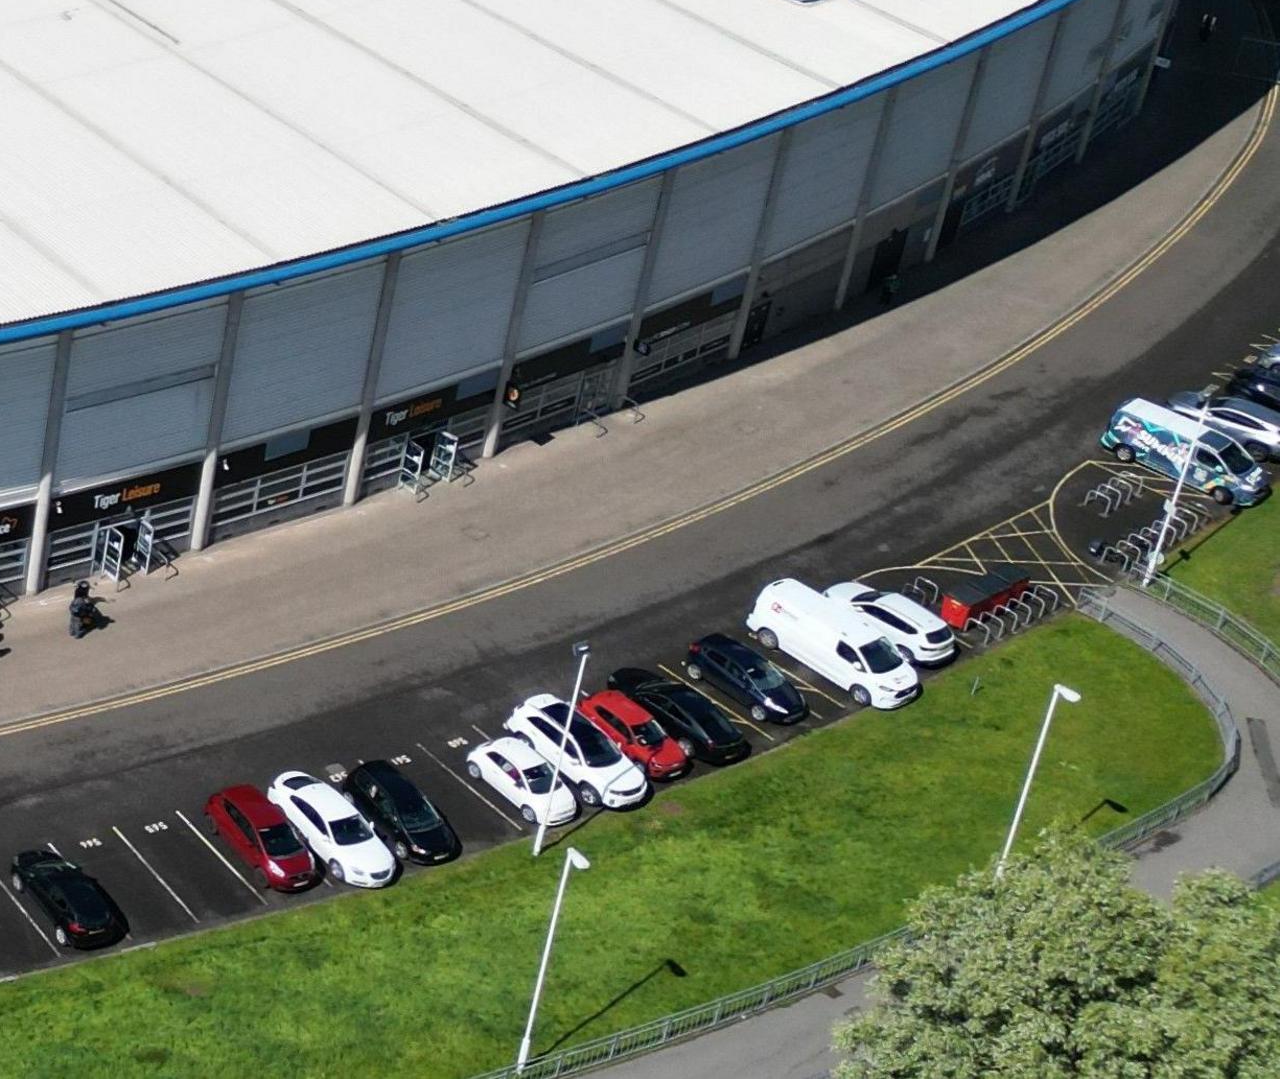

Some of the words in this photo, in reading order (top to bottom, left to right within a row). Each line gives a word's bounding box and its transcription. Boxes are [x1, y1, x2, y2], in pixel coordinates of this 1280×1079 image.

[385, 409, 409, 426] Tiger
[94, 493, 121, 509] Tiger
[121, 482, 161, 502] Leisure
